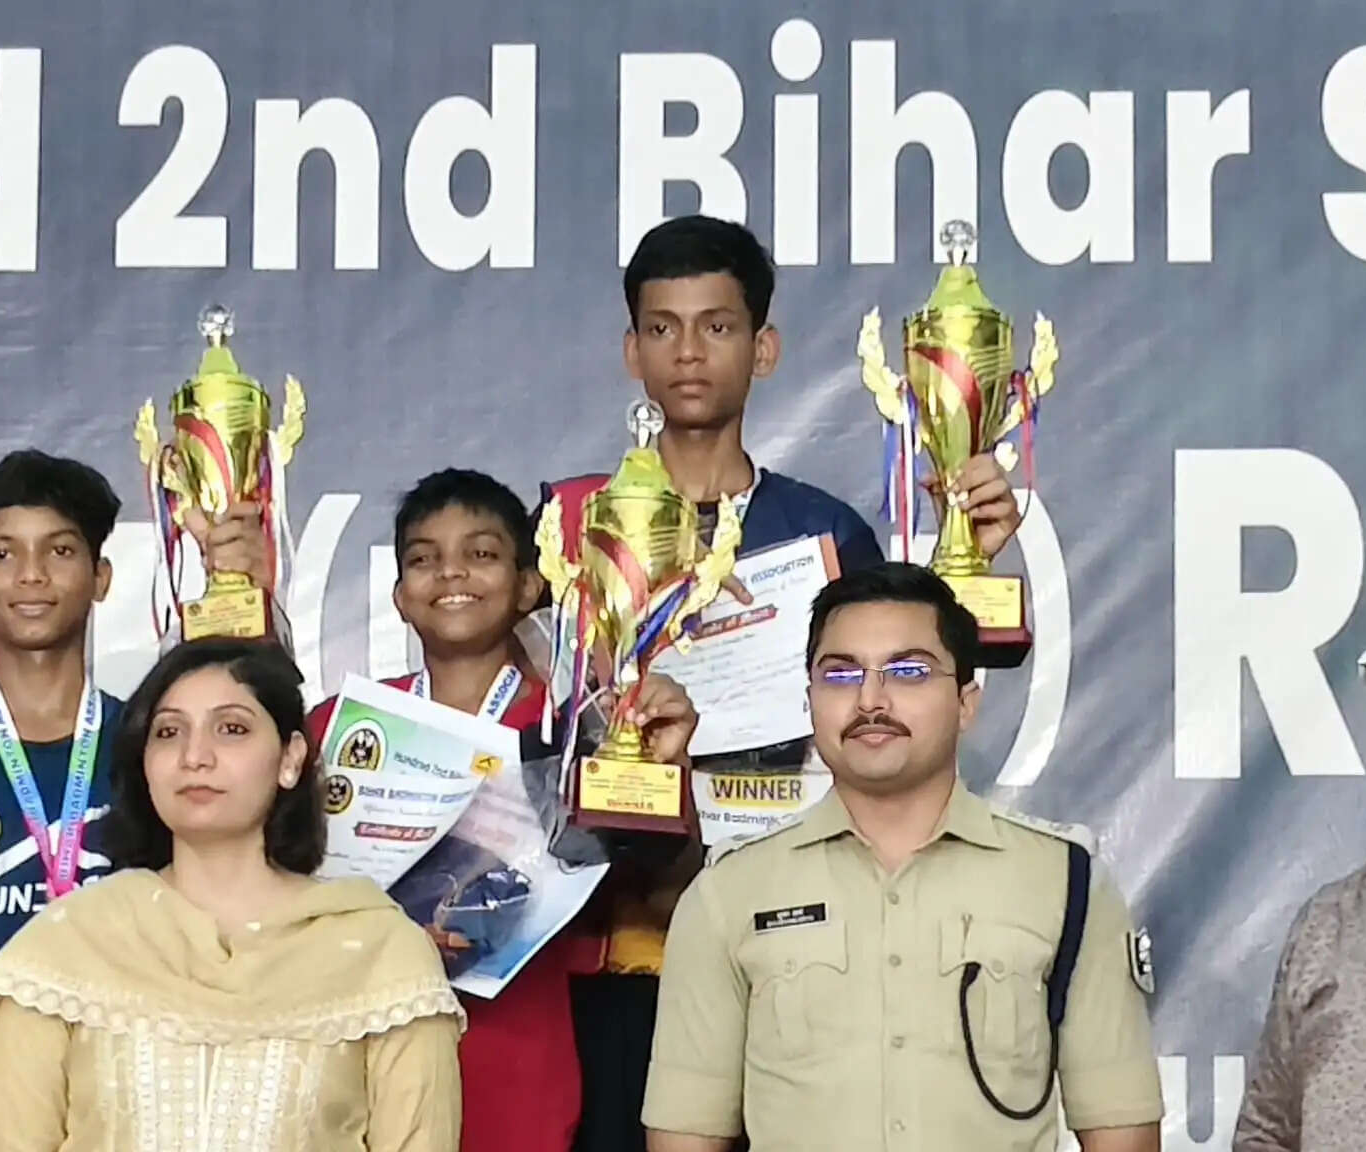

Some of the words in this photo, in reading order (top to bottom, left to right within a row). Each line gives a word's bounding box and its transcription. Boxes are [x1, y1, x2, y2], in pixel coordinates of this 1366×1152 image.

[115, 44, 537, 272] 2nd
[618, 19, 1250, 269] Bihar
[712, 779, 803, 801] WINNER
